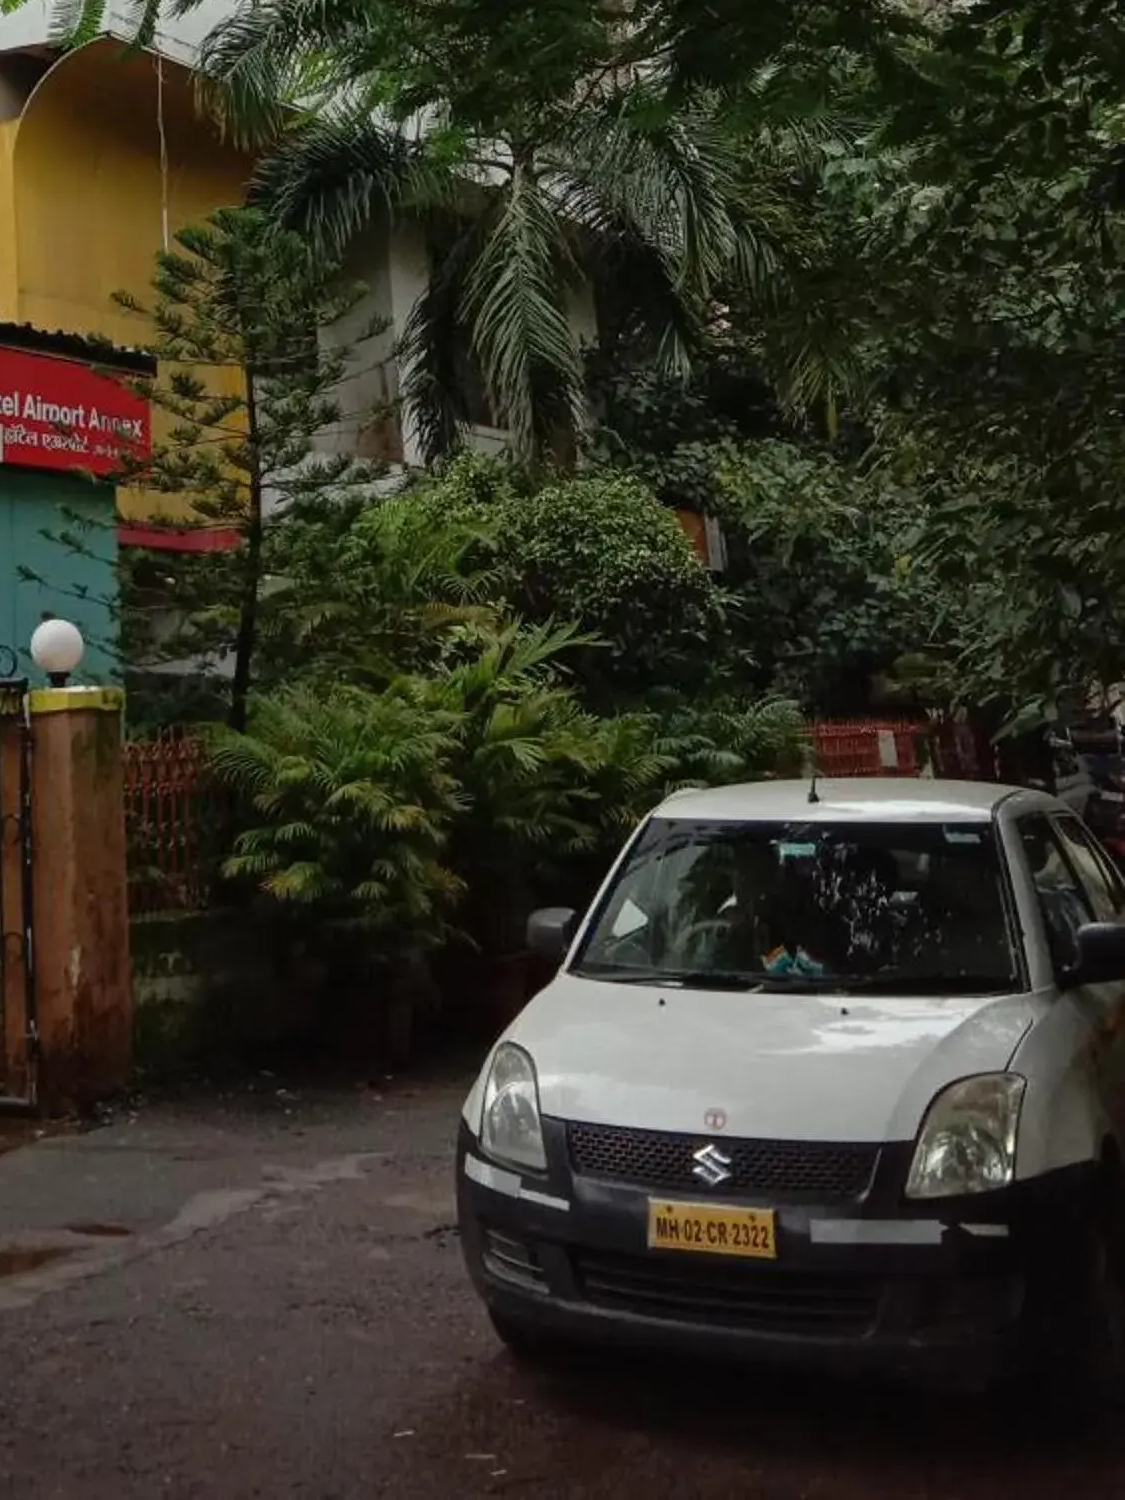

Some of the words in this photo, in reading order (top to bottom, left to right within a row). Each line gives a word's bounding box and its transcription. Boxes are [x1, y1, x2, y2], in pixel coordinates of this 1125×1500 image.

[24, 393, 85, 429] Airport
[656, 1217, 680, 1241] MH
[684, 1219, 702, 1243] 02
[732, 1223, 770, 1249] 2322
